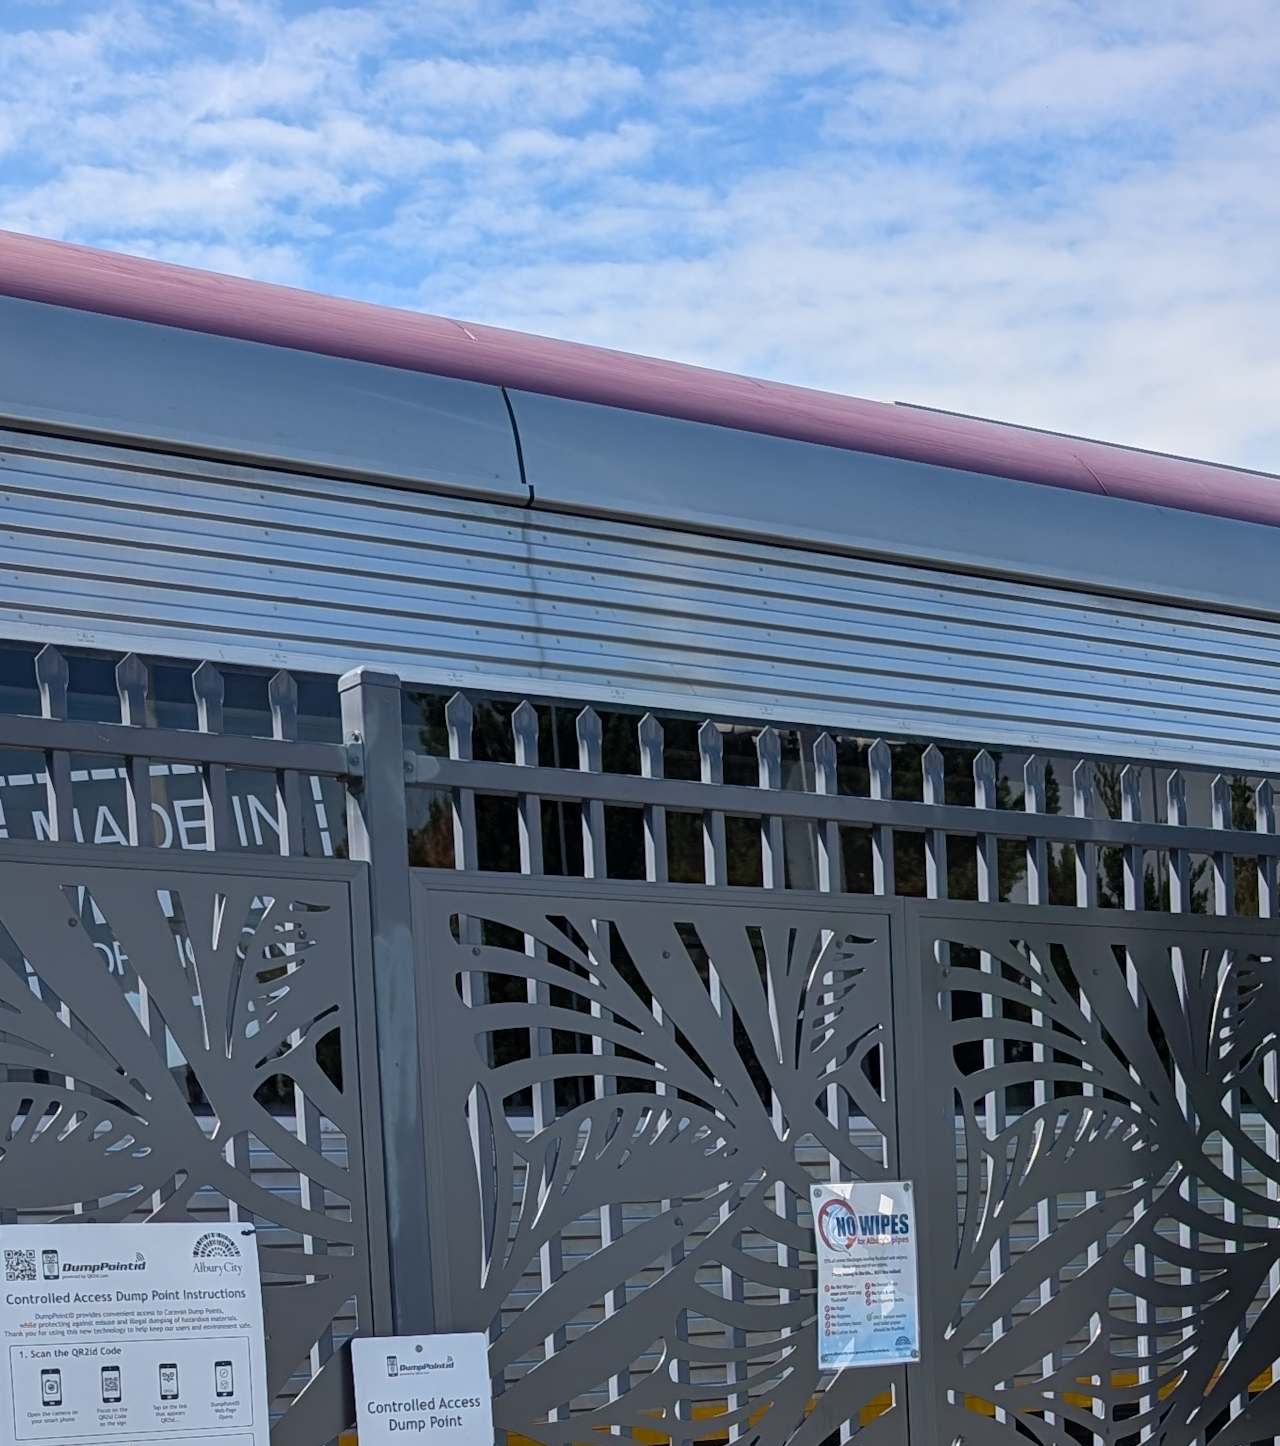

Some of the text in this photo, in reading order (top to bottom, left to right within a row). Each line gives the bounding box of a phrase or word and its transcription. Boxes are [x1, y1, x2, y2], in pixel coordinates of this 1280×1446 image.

[836, 1214, 909, 1236] NO WIPES
[62, 1262, 146, 1274] DumpPointid
[6, 1288, 246, 1304] Controlled Access Dump Point Instructions
[31, 1350, 51, 1358] Scan
[54, 1349, 69, 1357] the
[72, 1348, 98, 1358] QR2id
[100, 1347, 122, 1355] Code
[367, 1396, 481, 1414] Controlled Access
[389, 1415, 463, 1432] Dump Point
